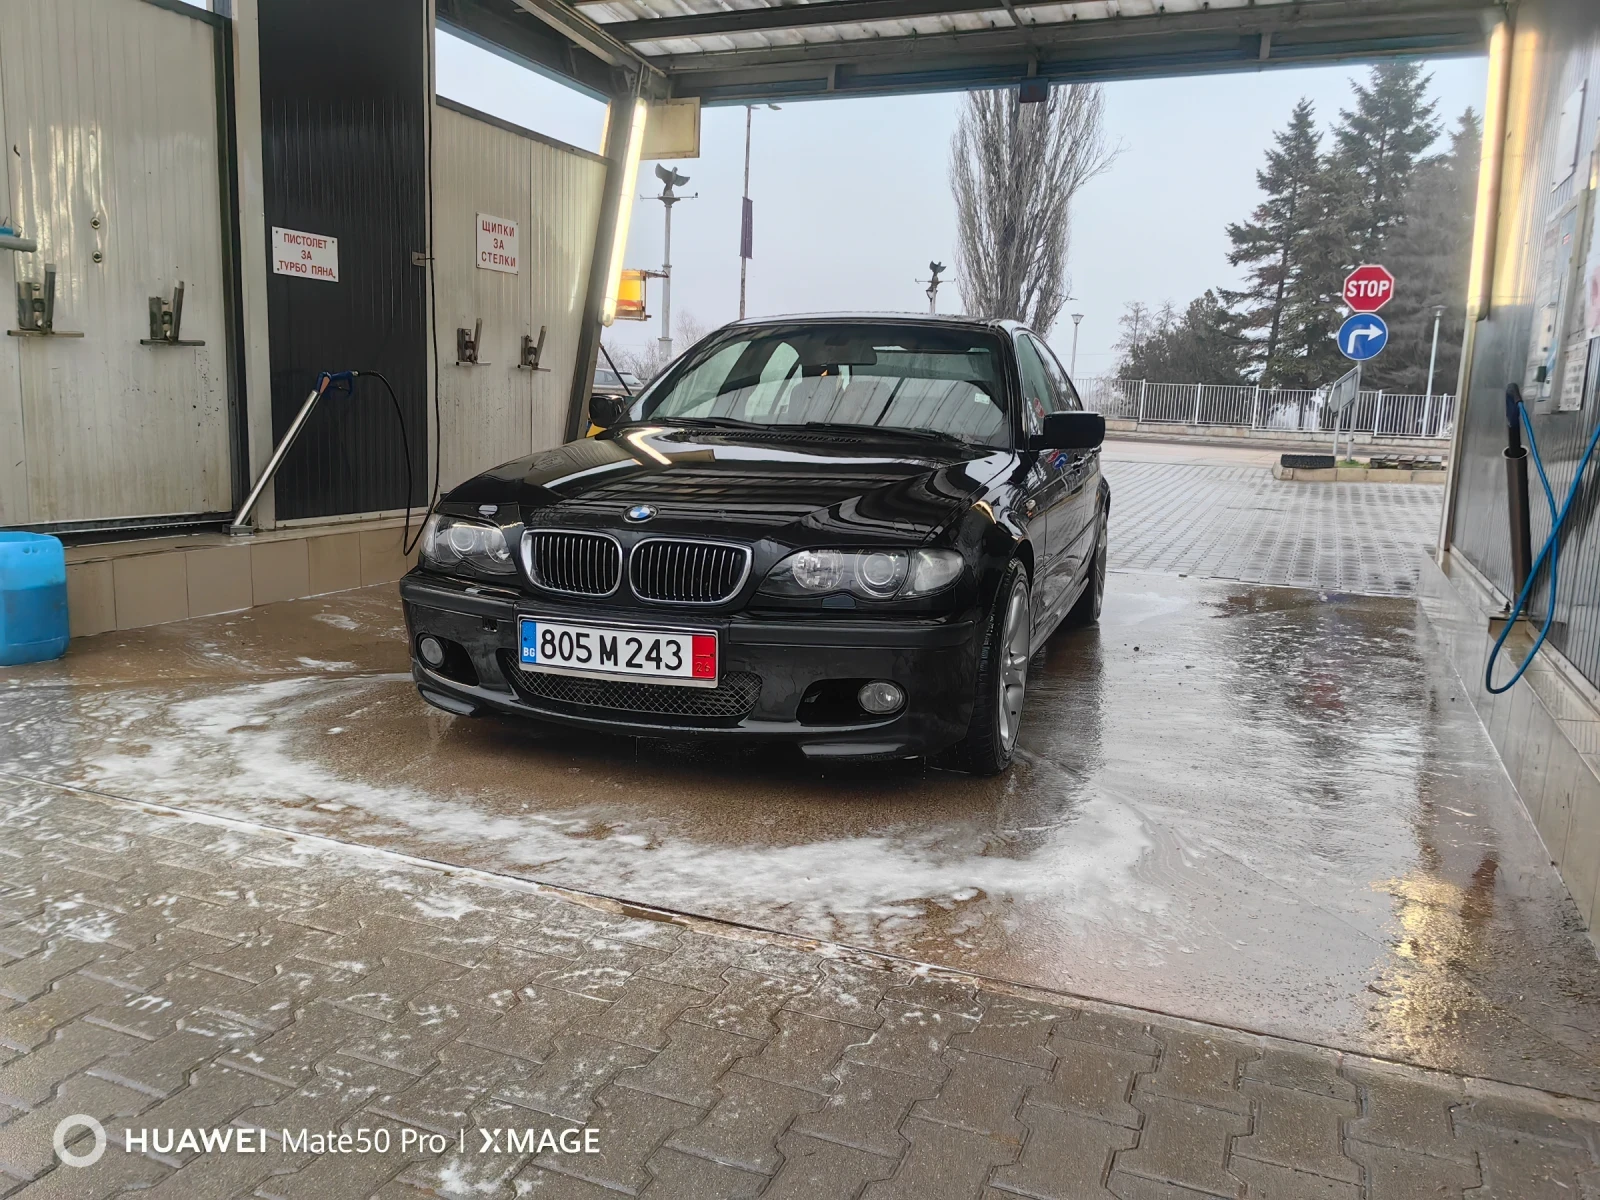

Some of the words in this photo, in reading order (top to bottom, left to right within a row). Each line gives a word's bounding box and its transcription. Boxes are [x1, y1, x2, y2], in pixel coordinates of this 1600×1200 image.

[482, 220, 515, 237] ЩИПКИ
[283, 233, 328, 249] ПИСТОЛЕТ
[493, 238, 504, 250] ЗА
[301, 250, 312, 260] ЗА
[481, 251, 516, 267] СТЕЛКИ
[279, 260, 307, 273] ТУРБО
[311, 265, 335, 277] ПЯНА
[1346, 280, 1390, 298] STOP
[523, 646, 536, 658] BG
[541, 629, 592, 663] 805
[600, 635, 618, 666] M
[625, 637, 683, 670] 243
